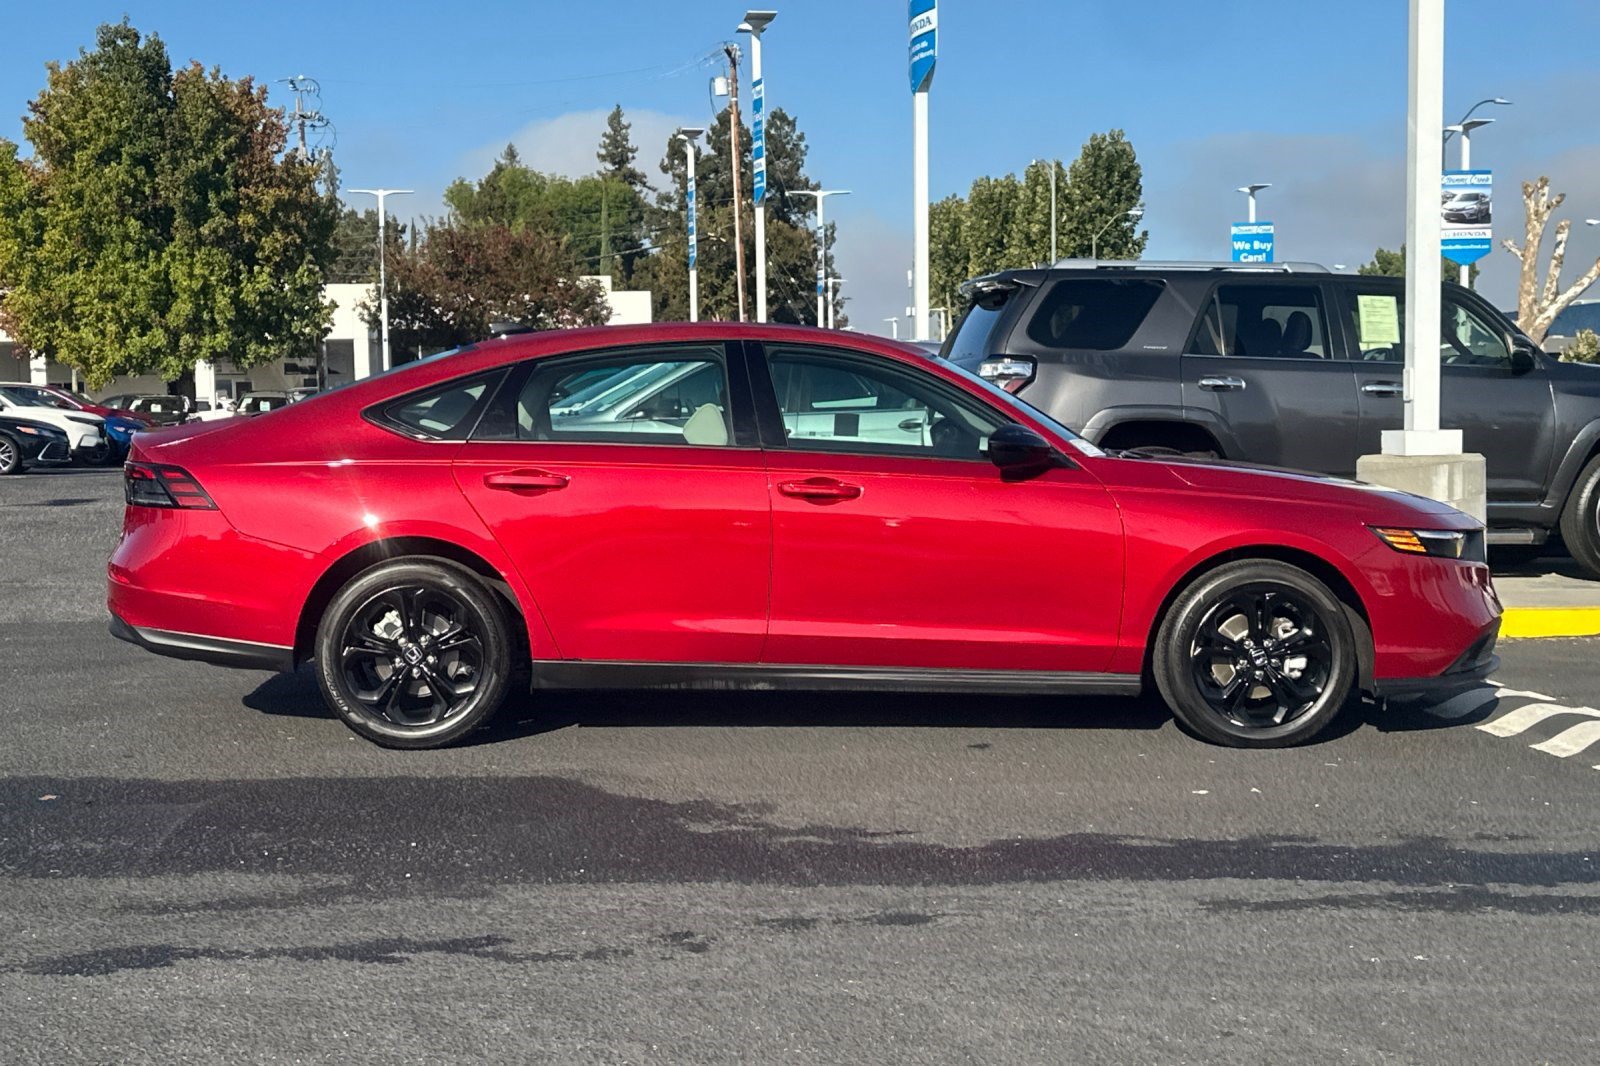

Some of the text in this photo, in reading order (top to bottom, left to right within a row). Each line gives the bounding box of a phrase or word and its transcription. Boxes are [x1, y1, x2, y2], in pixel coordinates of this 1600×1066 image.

[1233, 240, 1272, 251] We Buy
[1240, 252, 1266, 262] Cars!
